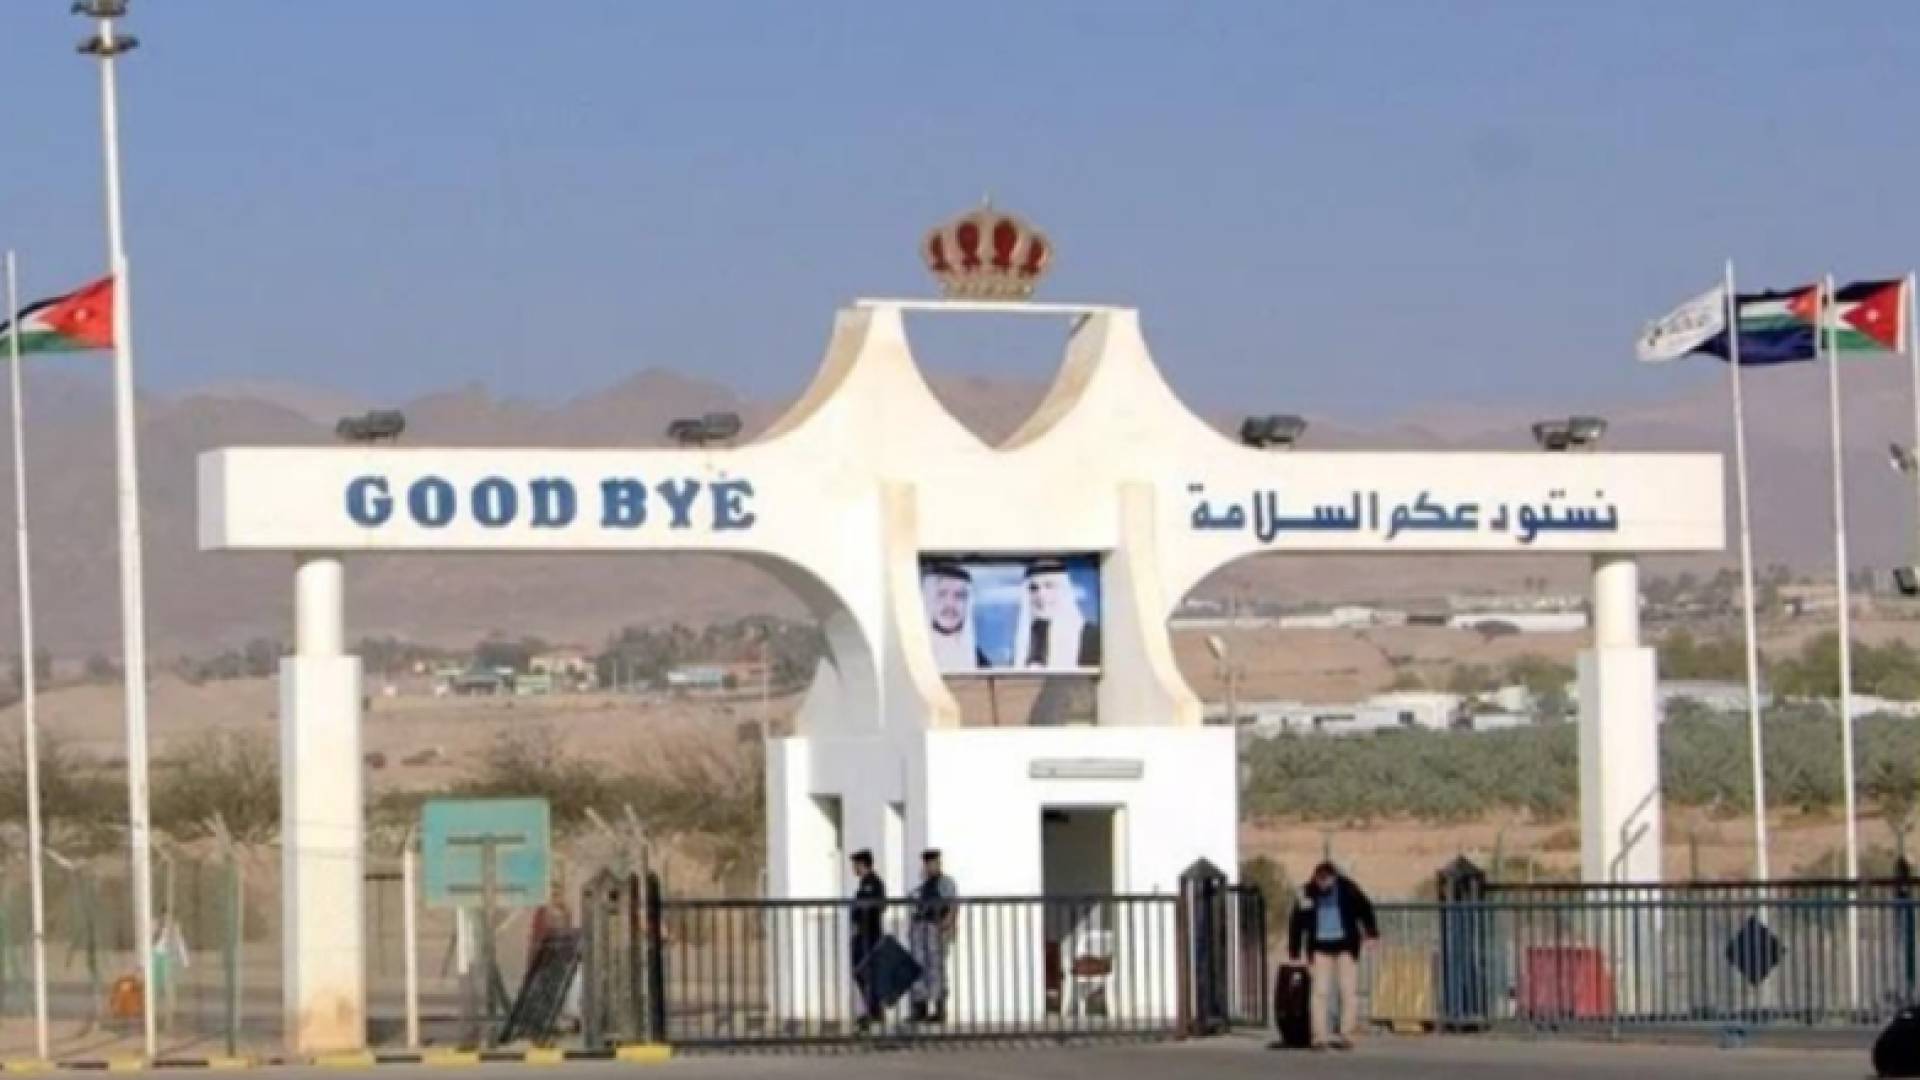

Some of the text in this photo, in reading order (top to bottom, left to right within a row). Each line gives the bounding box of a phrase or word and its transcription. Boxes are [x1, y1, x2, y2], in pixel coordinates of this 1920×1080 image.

[345, 475, 756, 531] GOOD BYE
[1187, 483, 1379, 544] السلامة
